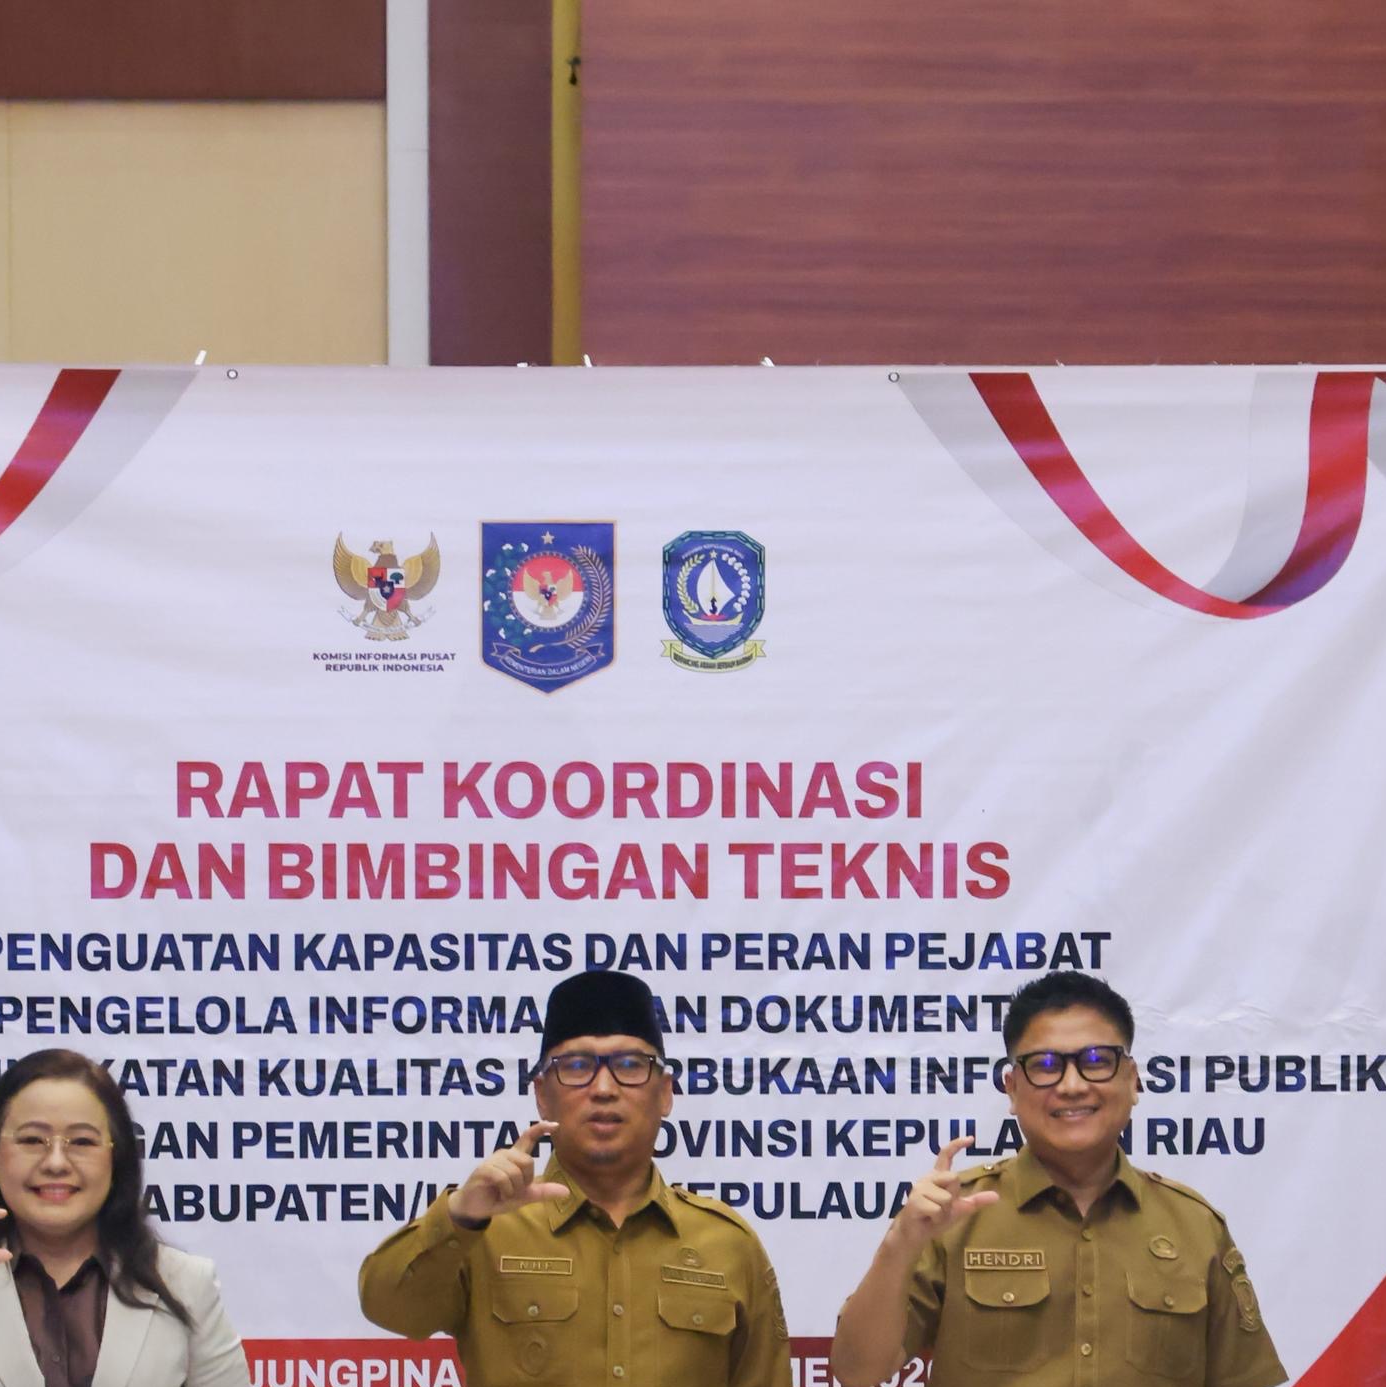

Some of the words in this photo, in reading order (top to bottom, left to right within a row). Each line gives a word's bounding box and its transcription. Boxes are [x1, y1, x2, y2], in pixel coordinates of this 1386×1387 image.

[313, 652, 352, 661] KOMISI
[355, 652, 417, 661] INFORMASI
[420, 652, 456, 661] PUSAT
[325, 663, 379, 672] REPUBLIK
[383, 663, 444, 672] INDONESIA
[177, 762, 423, 818] RAPAT
[444, 761, 921, 819] KOORDINASI
[90, 843, 245, 899] DAN
[269, 843, 708, 900] BIMBINGAN
[729, 842, 1010, 900] TEKNIS
[295, 933, 572, 971] KAPASITAS
[587, 933, 687, 970] DAN
[702, 933, 870, 970] PERAN
[886, 932, 1111, 970] PEJABAT
[310, 996, 545, 1034] INFORMA
[722, 995, 1011, 1033] DOKUMENT
[259, 1058, 505, 1096] KUALITAS
[518, 1057, 895, 1095] KRBUKAAN
[653, 1119, 811, 1157] OVINSI
[827, 1118, 1132, 1156] KEPULA
[1147, 1117, 1264, 1156] RIAU
[968, 1252, 1041, 1266] HENDRI
